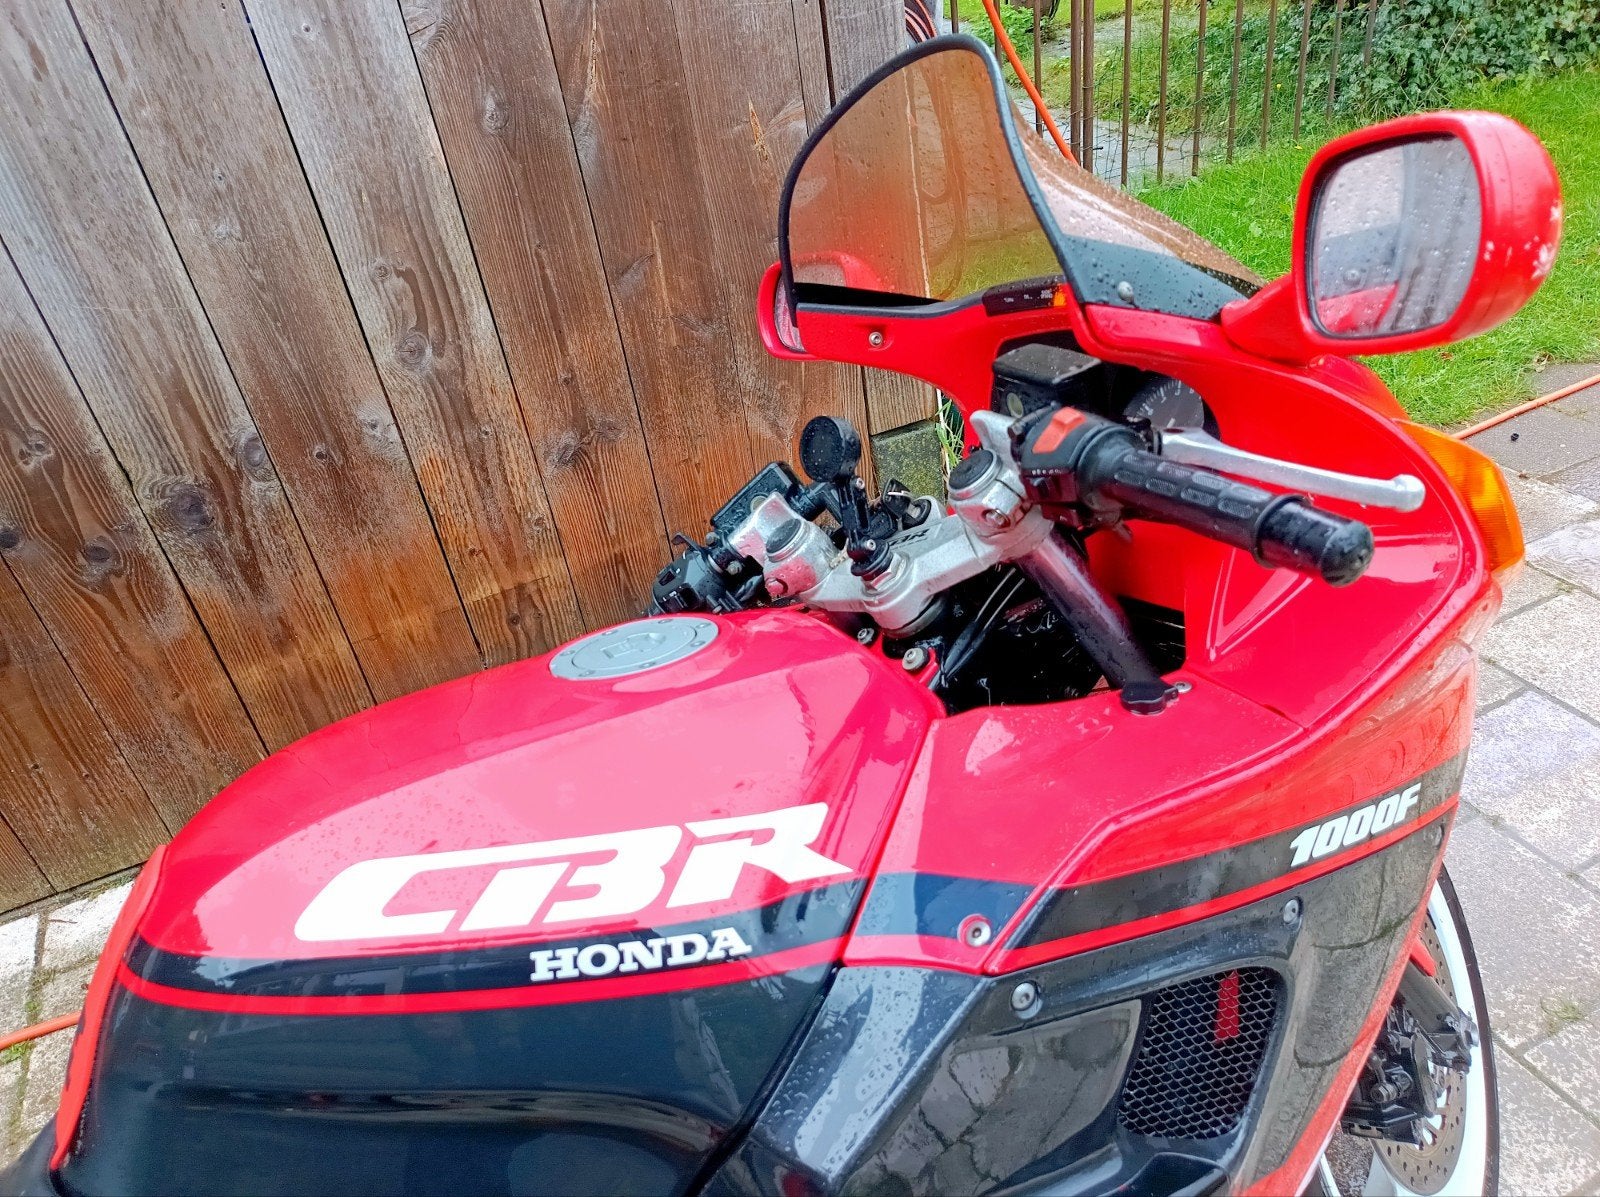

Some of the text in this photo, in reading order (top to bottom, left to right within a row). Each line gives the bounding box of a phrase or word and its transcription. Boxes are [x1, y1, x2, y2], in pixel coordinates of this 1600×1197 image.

[1290, 783, 1421, 867] 1000F
[294, 802, 854, 941] CBR
[530, 928, 752, 982] HONDA
